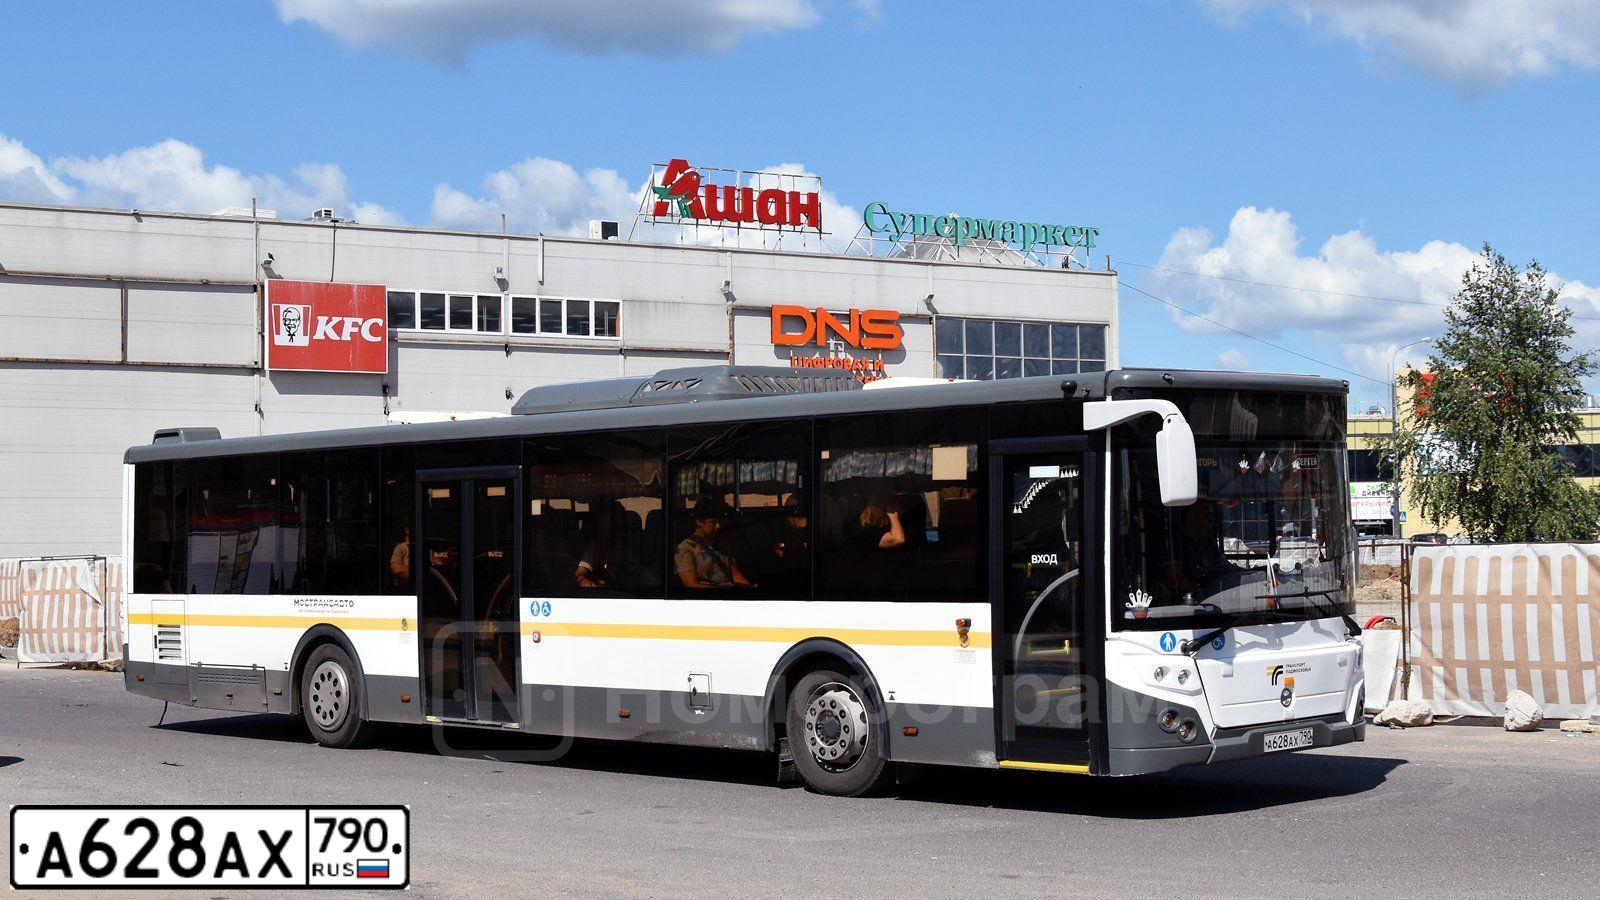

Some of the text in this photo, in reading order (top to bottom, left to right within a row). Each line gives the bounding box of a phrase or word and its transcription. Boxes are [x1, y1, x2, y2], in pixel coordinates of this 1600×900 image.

[652, 158, 820, 228] Ашан
[864, 200, 1101, 252] Супермаркет
[312, 315, 384, 342] KFC
[770, 304, 904, 350] DNS
[790, 355, 885, 372] ЦИФРОВАЯ И
[1031, 554, 1058, 565] ВХОД
